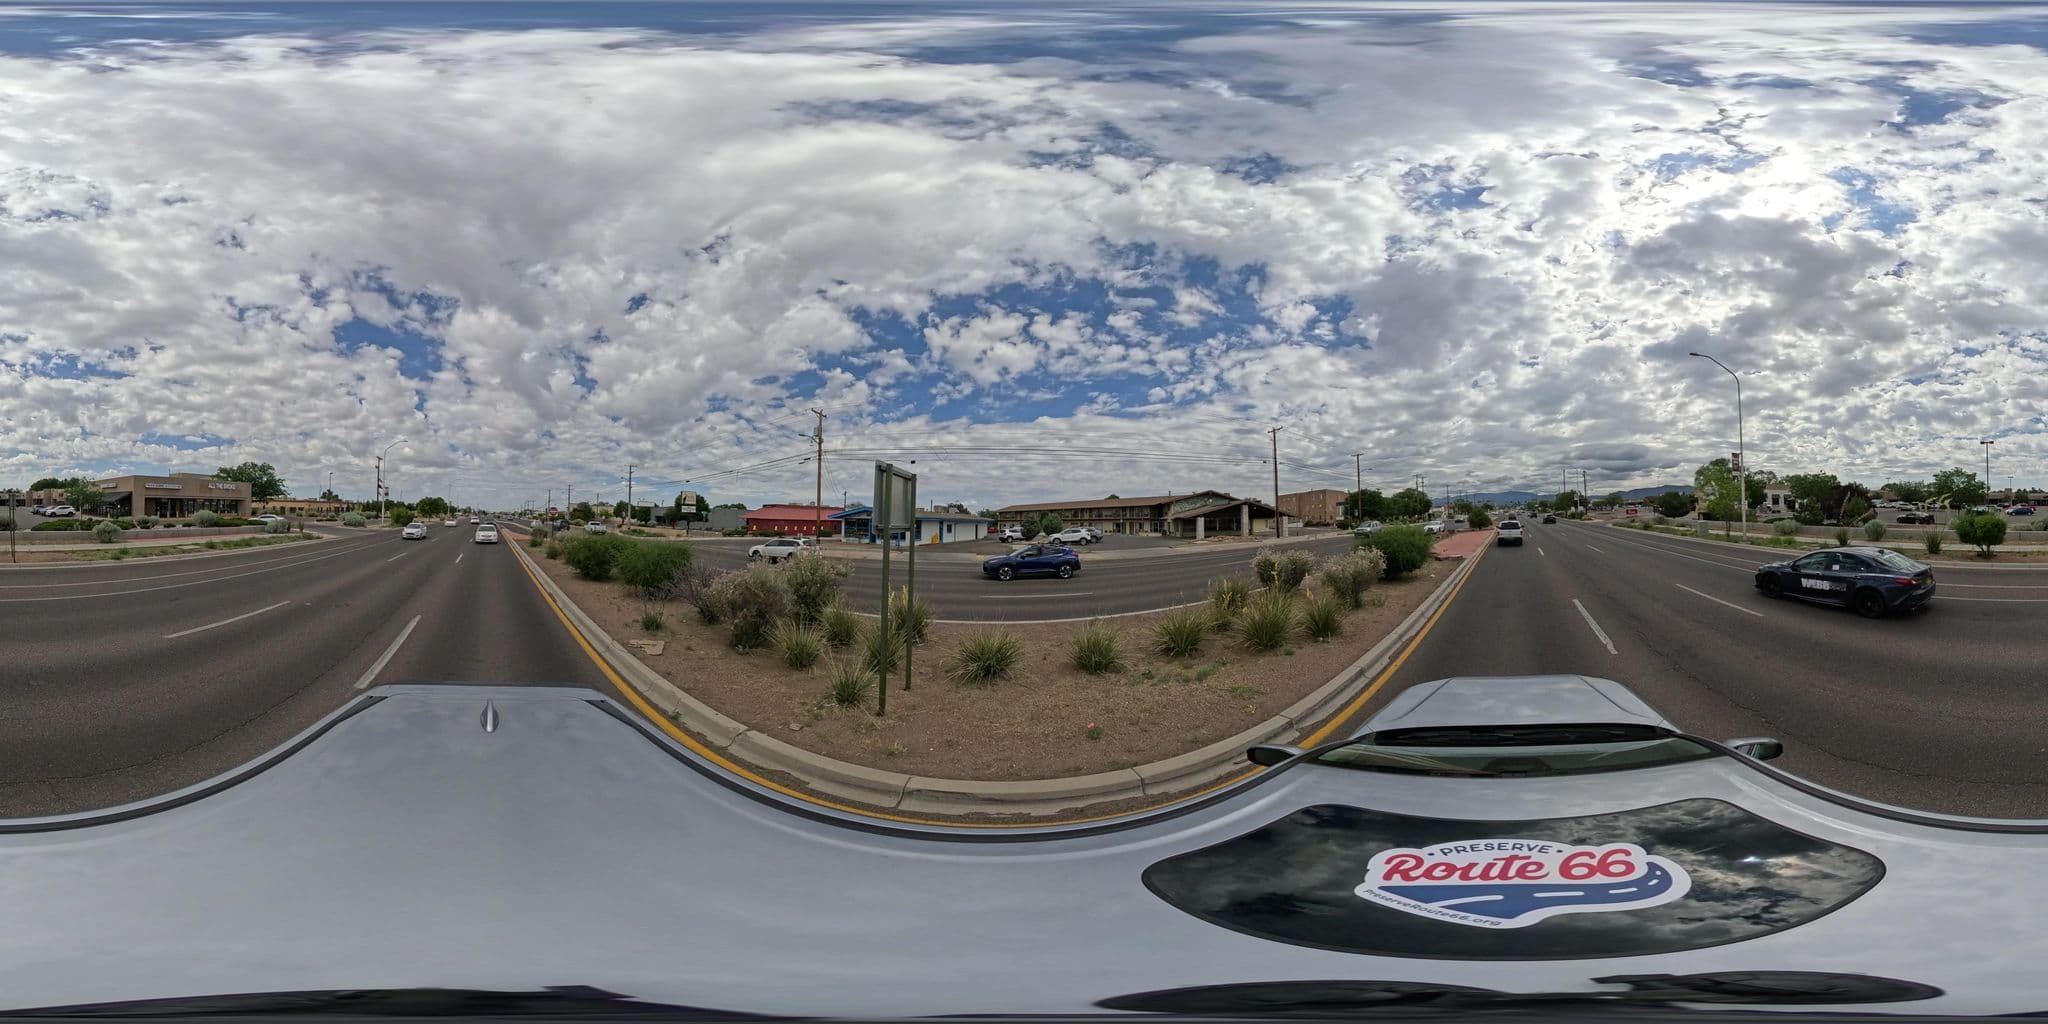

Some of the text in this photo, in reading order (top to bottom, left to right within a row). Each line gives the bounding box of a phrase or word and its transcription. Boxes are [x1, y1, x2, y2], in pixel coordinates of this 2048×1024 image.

[1382, 849, 1635, 882] Route 66
[1440, 842, 1552, 856] PRESERVE
[1363, 888, 1502, 927] PreserveRoute66.org
